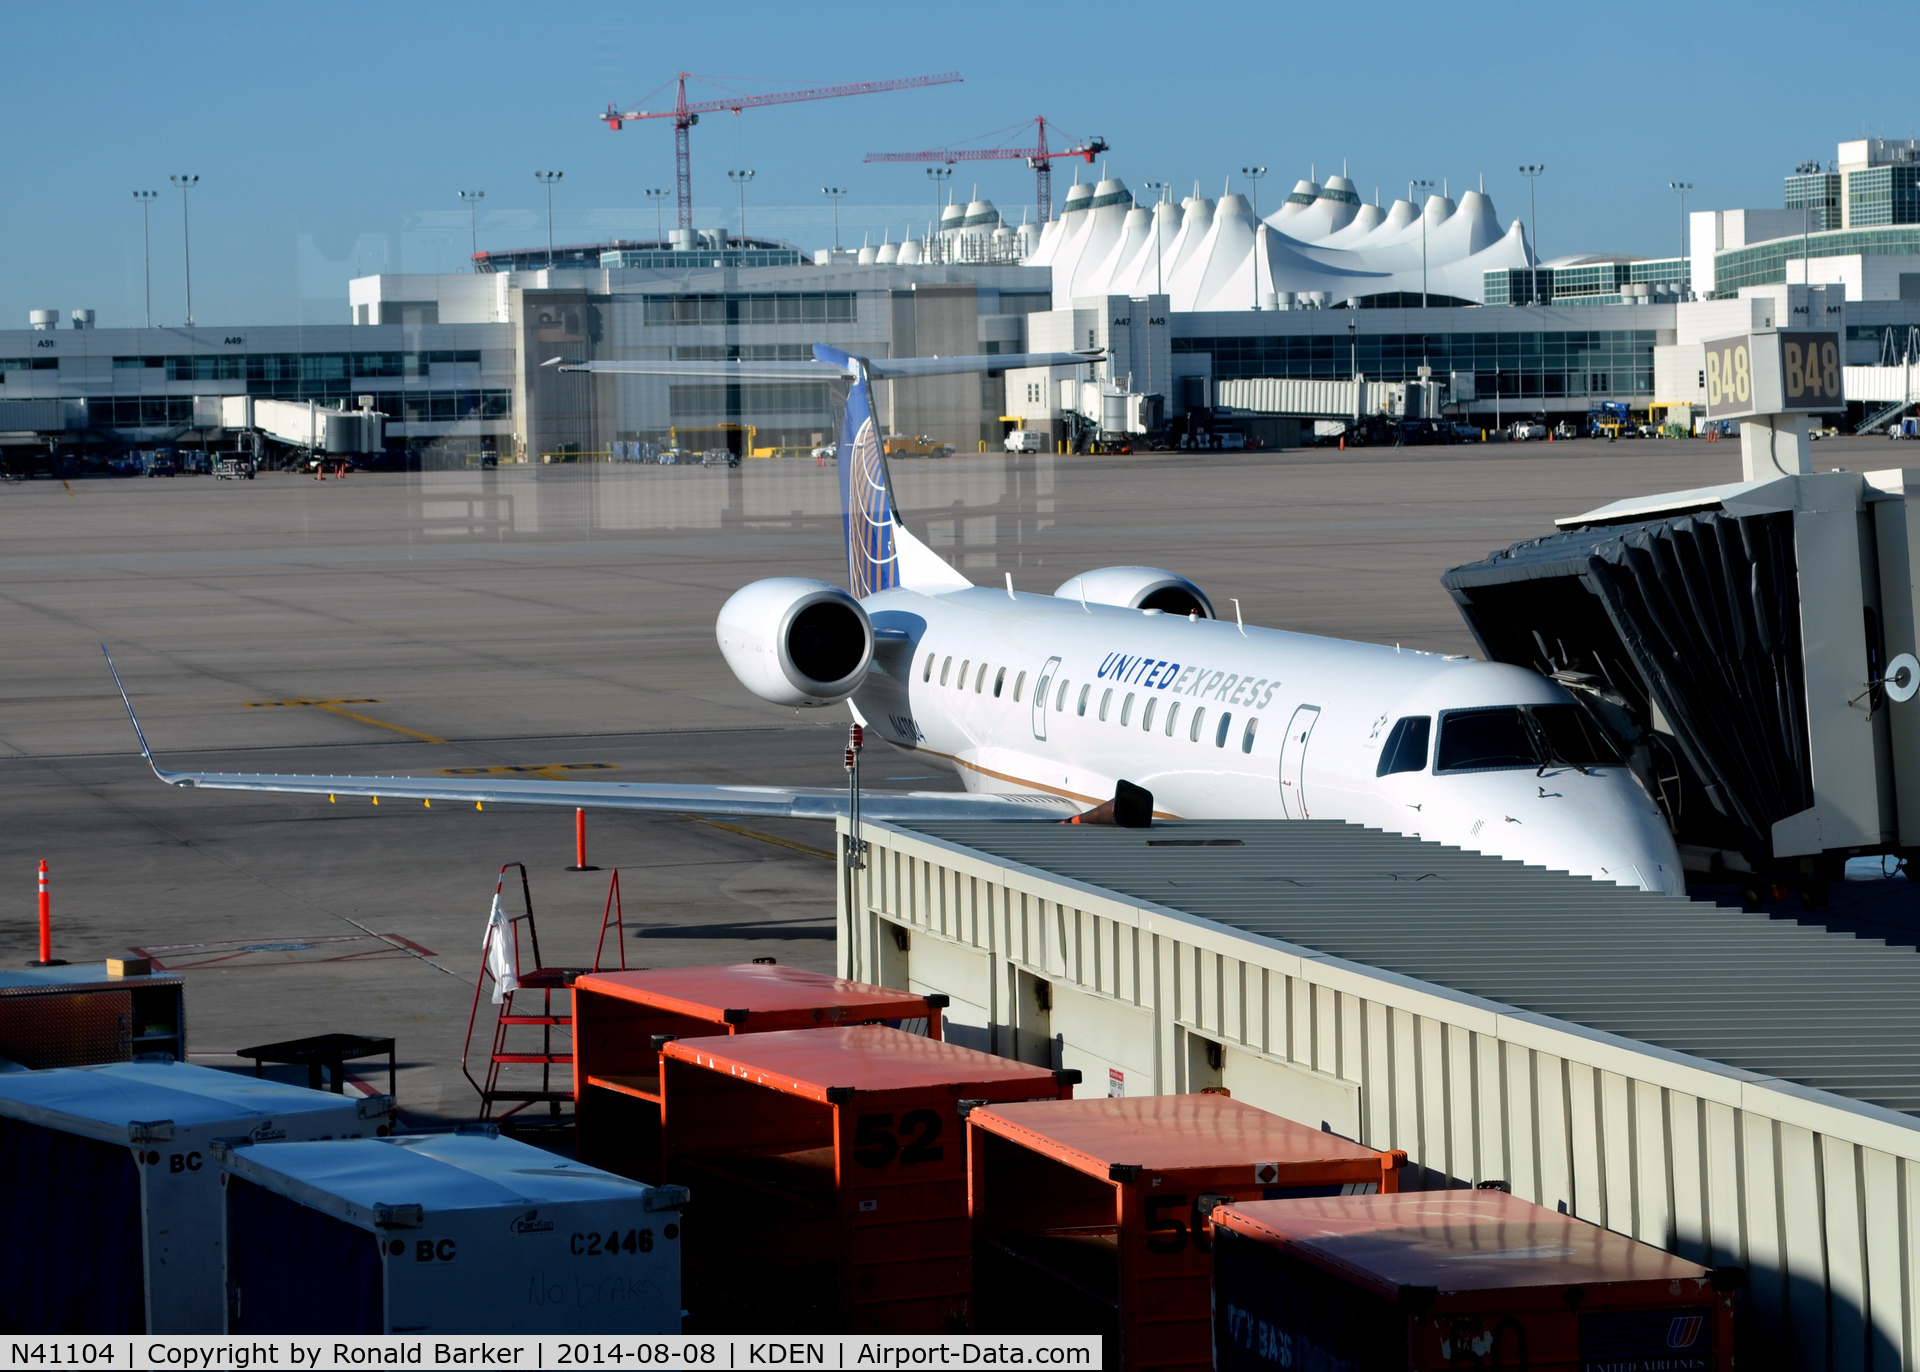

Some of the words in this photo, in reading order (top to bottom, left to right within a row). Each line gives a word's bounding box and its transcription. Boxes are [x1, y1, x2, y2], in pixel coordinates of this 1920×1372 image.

[1114, 317, 1131, 326] A47
[1149, 317, 1166, 326] A45
[1793, 306, 1809, 314] A43
[37, 339, 54, 348] A51
[224, 336, 242, 345] A49
[1706, 345, 1750, 407] B48
[1784, 341, 1840, 398] B48
[853, 1109, 944, 1169] 52
[170, 1151, 203, 1174] BC
[416, 1238, 456, 1263] BC
[570, 1229, 654, 1256] C2446
[529, 1272, 563, 1306] No
